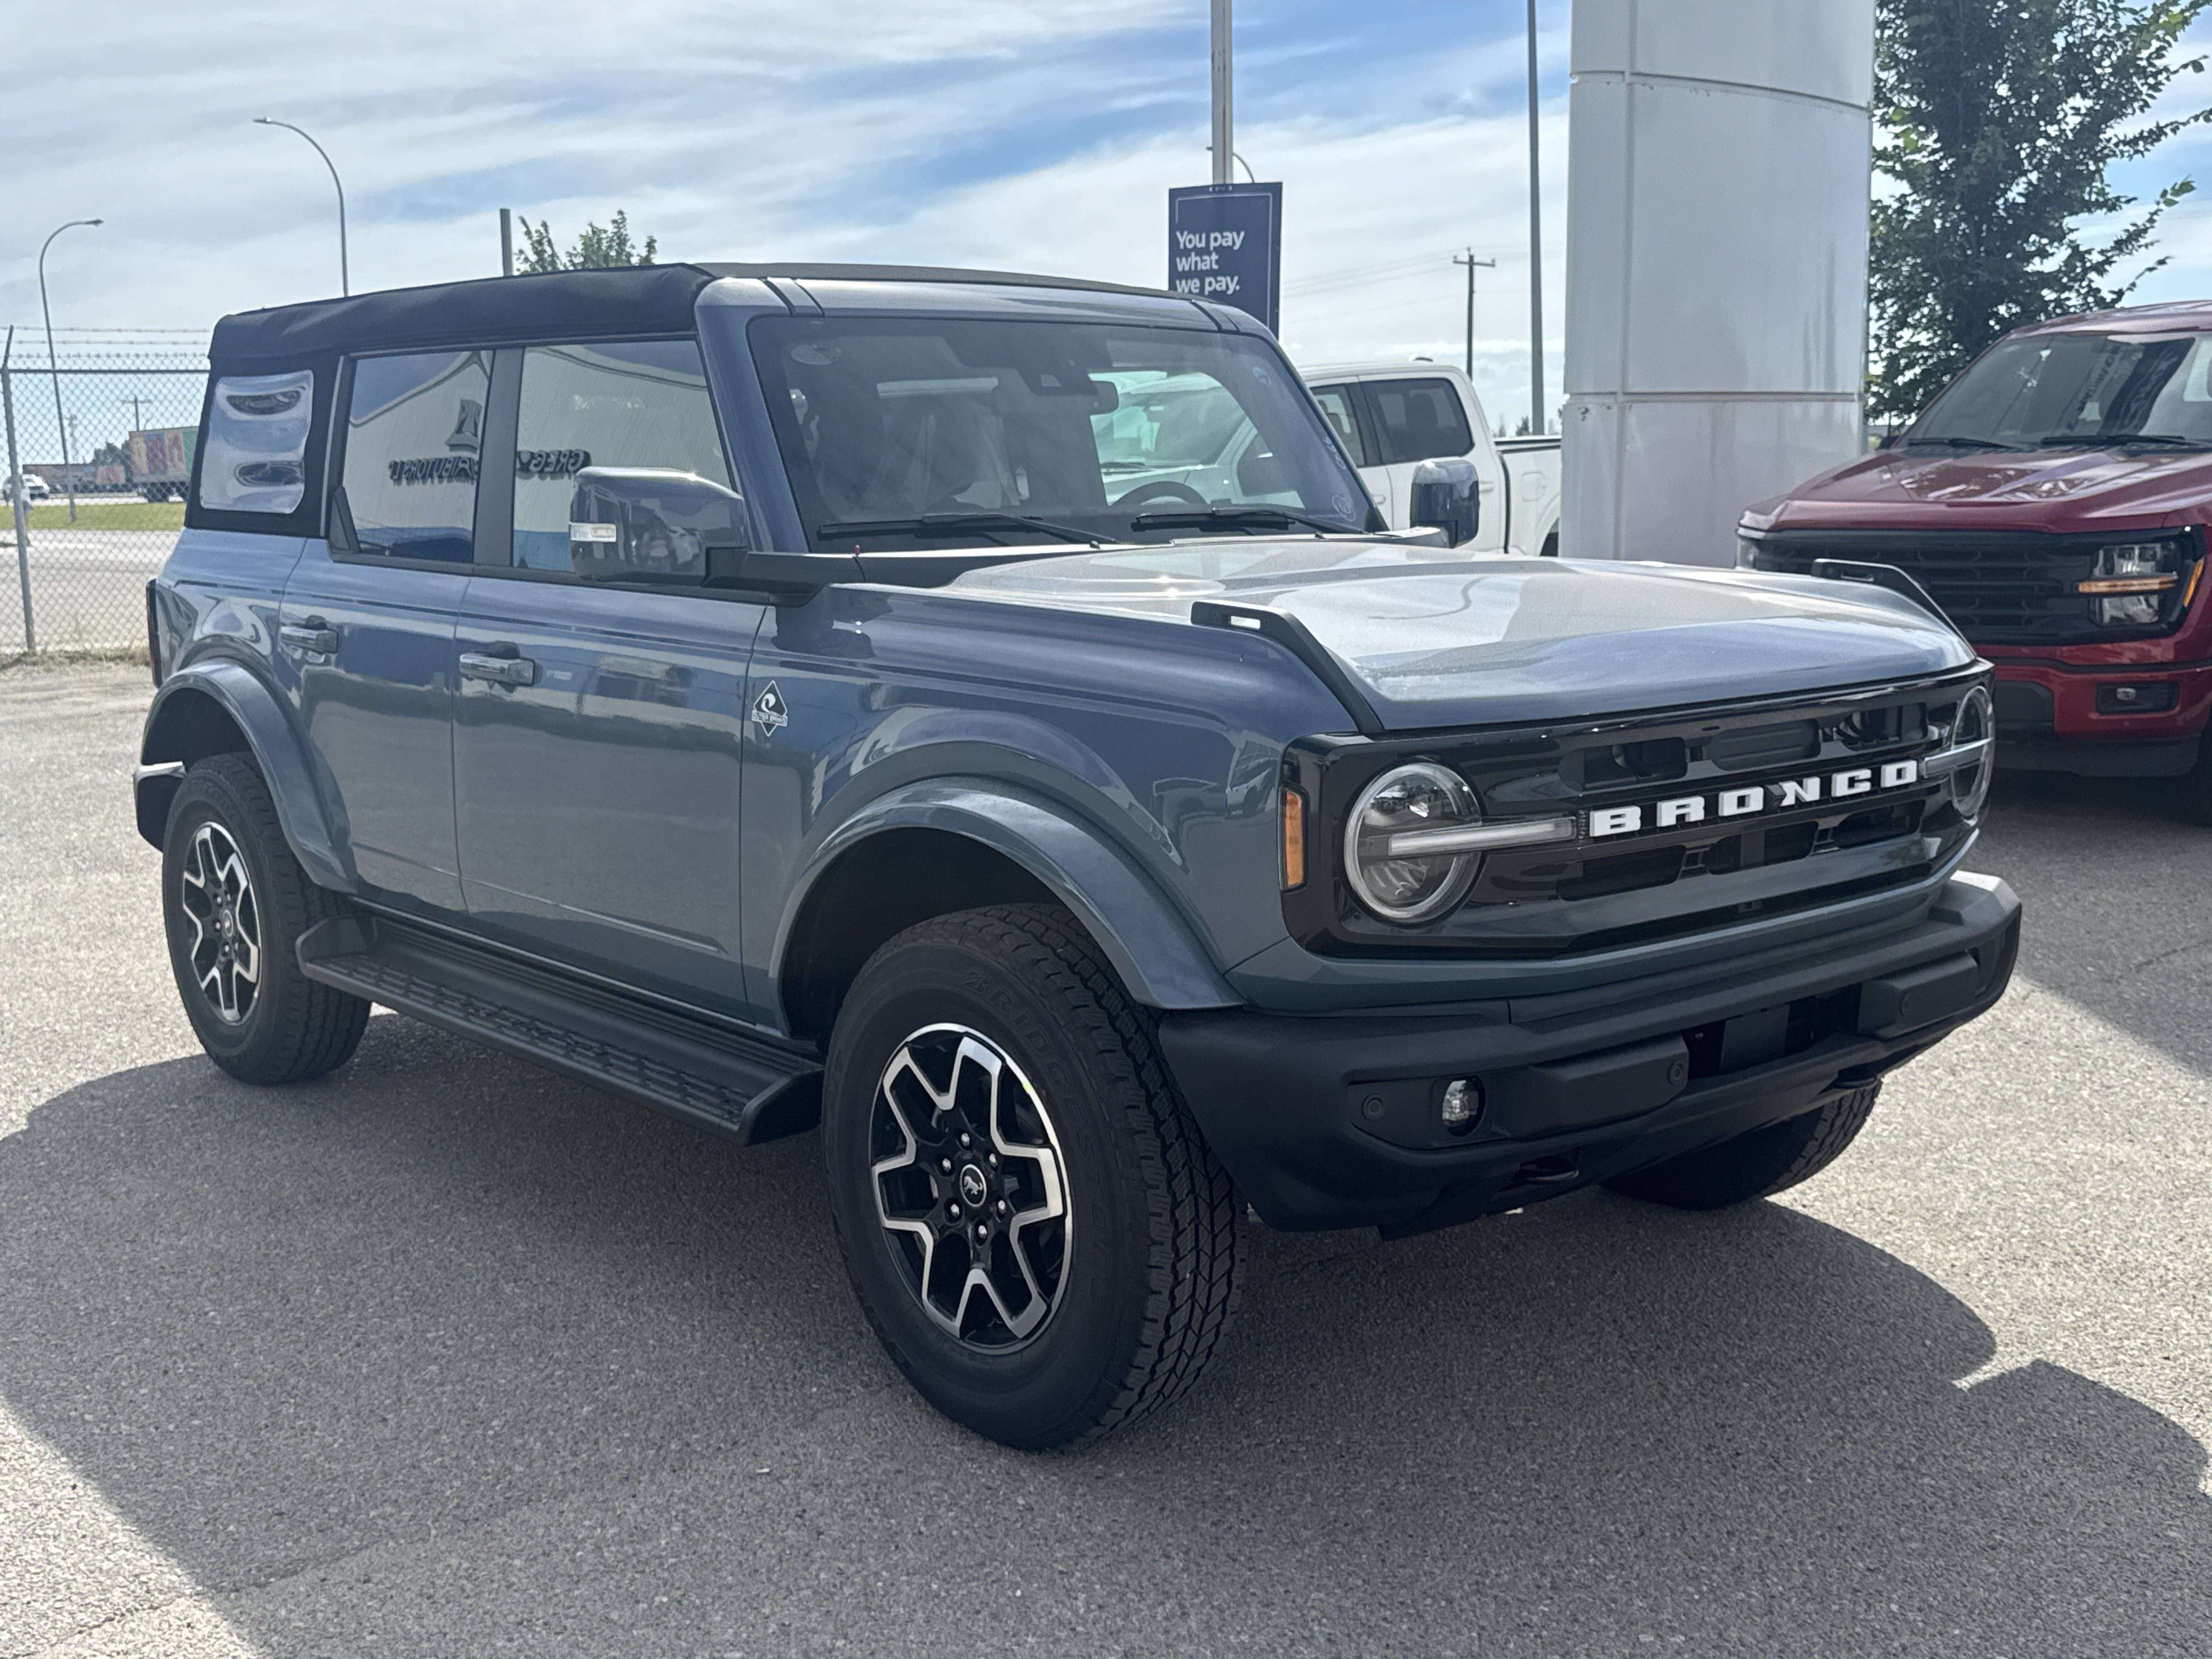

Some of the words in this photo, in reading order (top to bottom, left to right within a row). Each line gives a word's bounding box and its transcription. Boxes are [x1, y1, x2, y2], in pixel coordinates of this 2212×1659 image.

[1176, 230, 1206, 250] You
[1210, 231, 1245, 250] pay
[1176, 252, 1219, 272] what
[1176, 278, 1200, 293] we
[1205, 275, 1240, 295] pay.
[1589, 759, 1918, 837] BRONCO
